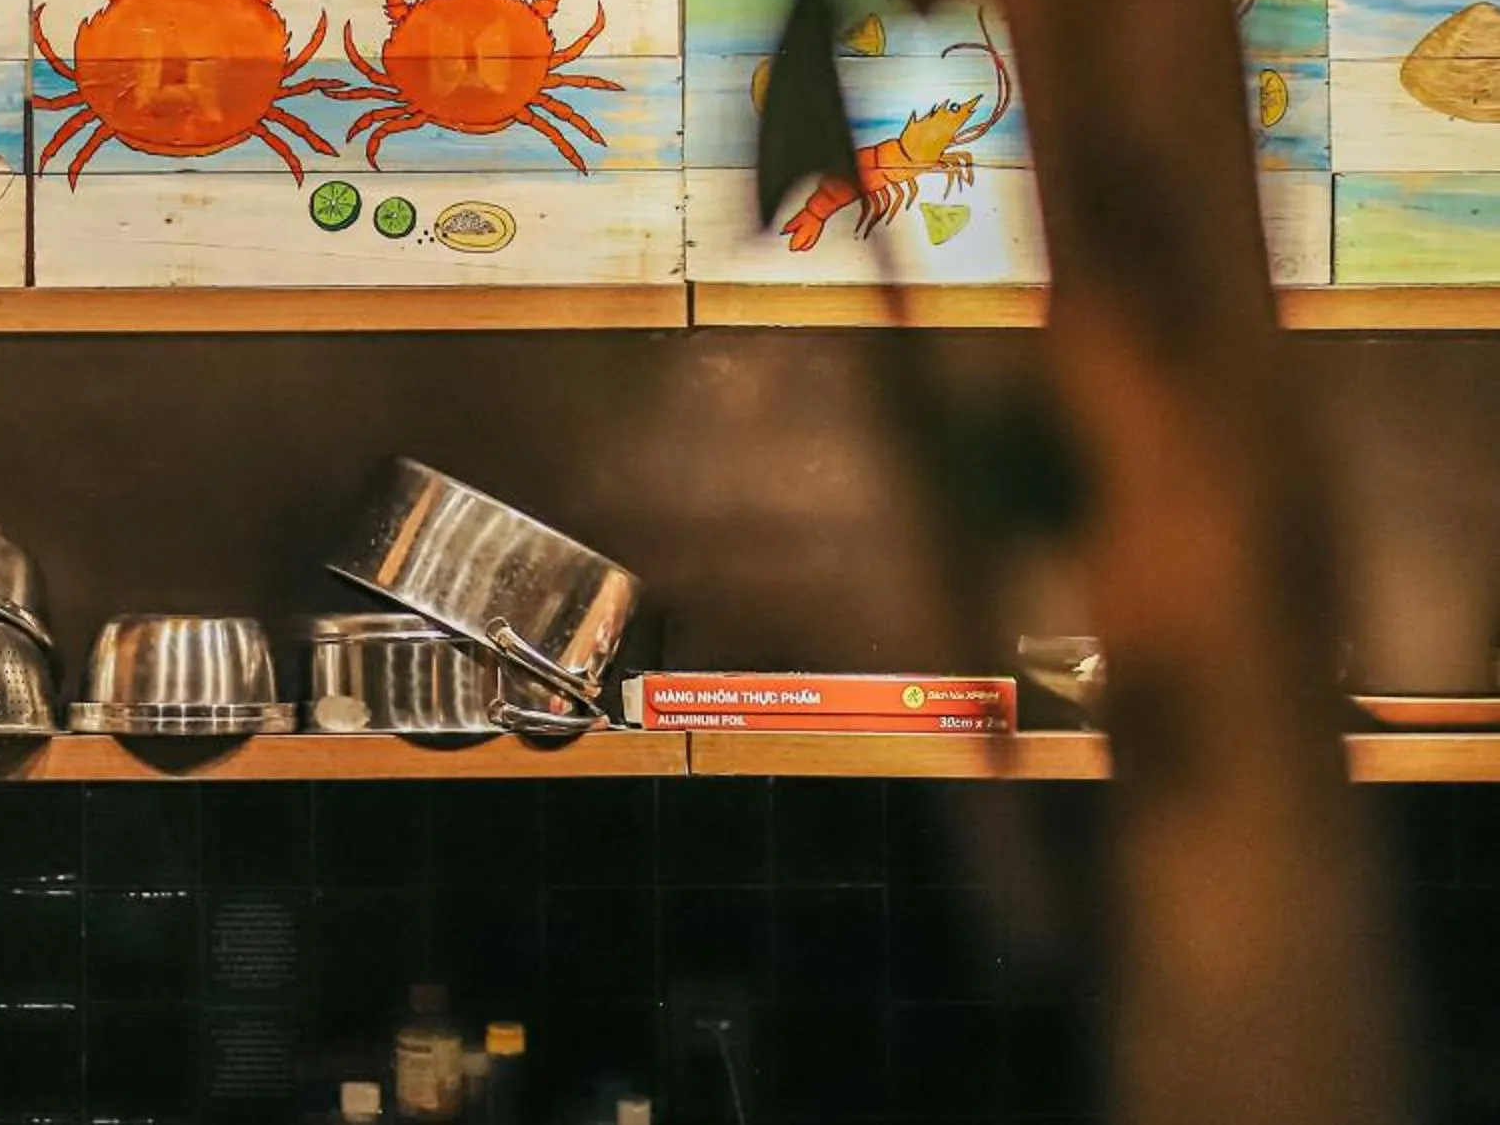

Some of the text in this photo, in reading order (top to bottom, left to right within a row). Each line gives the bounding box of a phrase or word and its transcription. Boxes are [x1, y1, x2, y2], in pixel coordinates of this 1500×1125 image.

[697, 688, 738, 703] NHÔM
[741, 691, 778, 706] THỰC
[781, 688, 821, 704] PHẨM
[658, 714, 746, 726] ALUMINUM FOIL
[940, 716, 973, 728] 30cm
[975, 720, 983, 728] x
